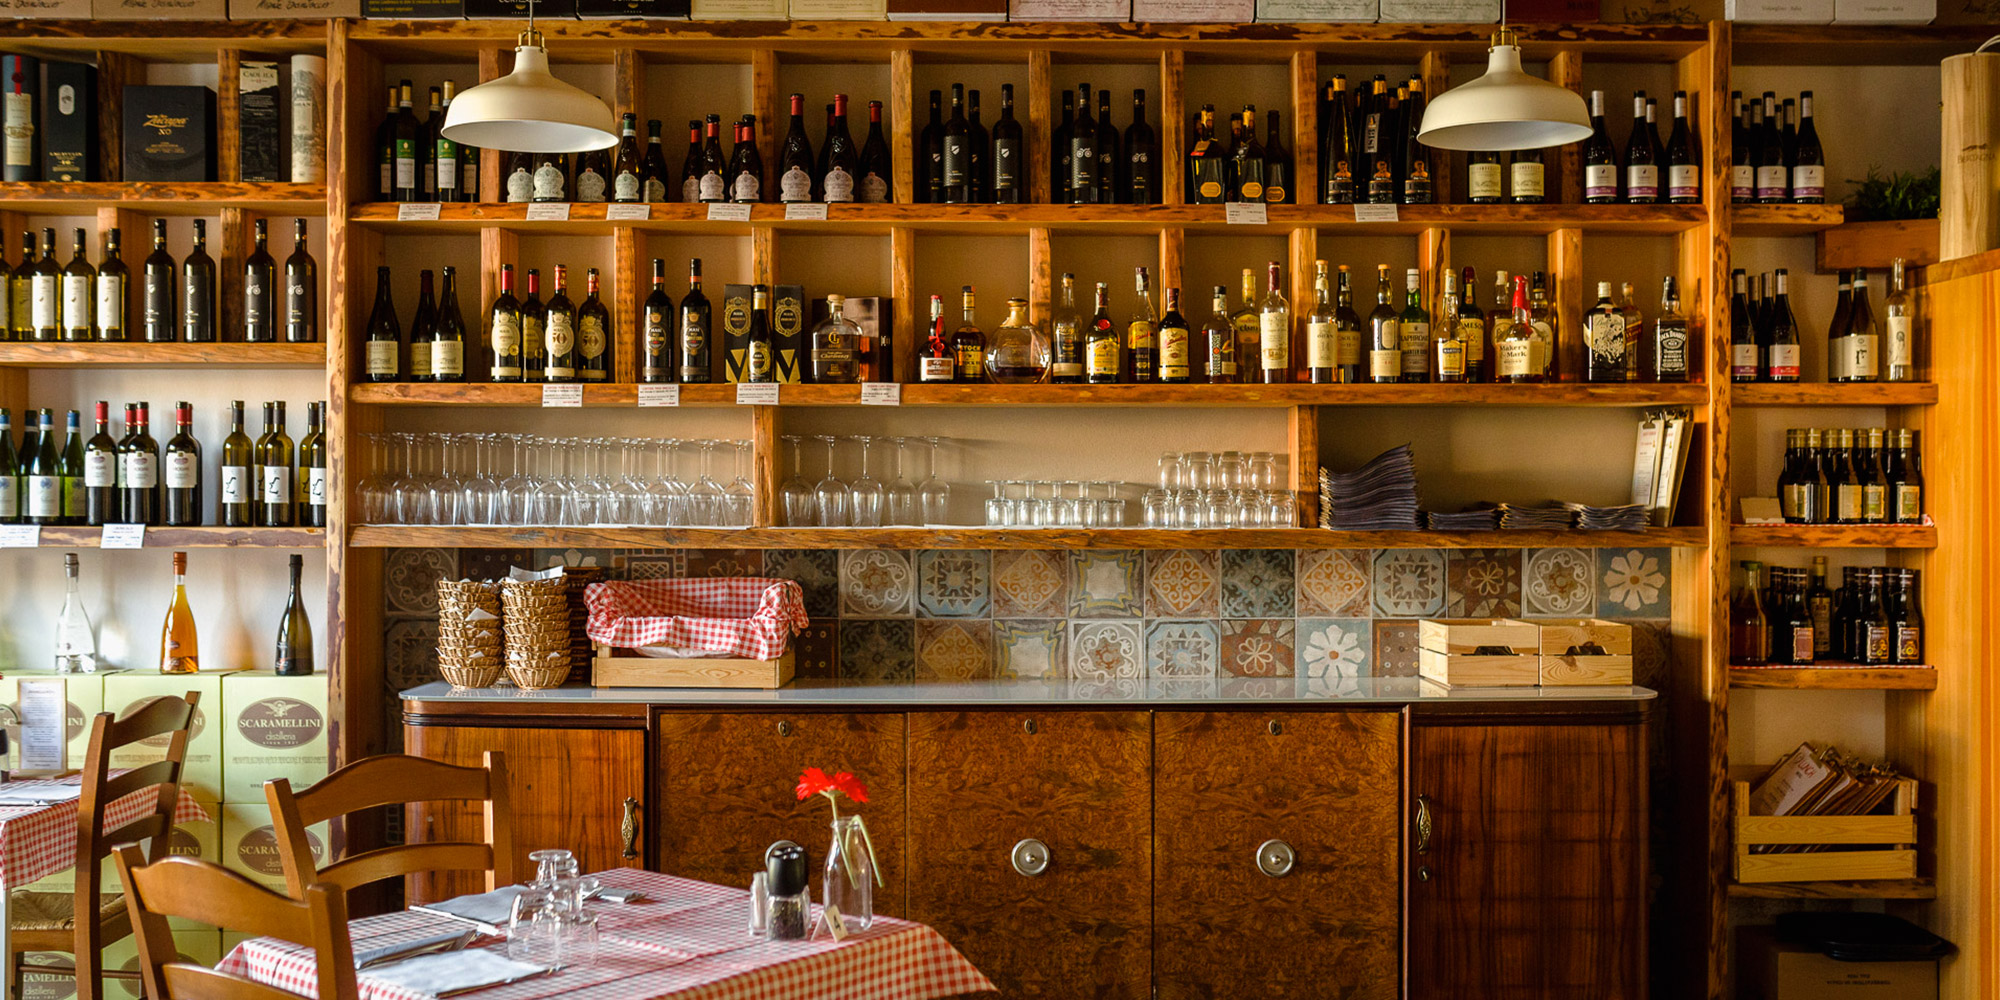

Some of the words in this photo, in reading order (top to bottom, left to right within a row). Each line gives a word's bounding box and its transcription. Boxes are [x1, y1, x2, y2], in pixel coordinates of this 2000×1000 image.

[158, 128, 172, 136] XO
[1500, 344, 1528, 352] Maker's
[239, 719, 321, 728] SCARAMELLINI
